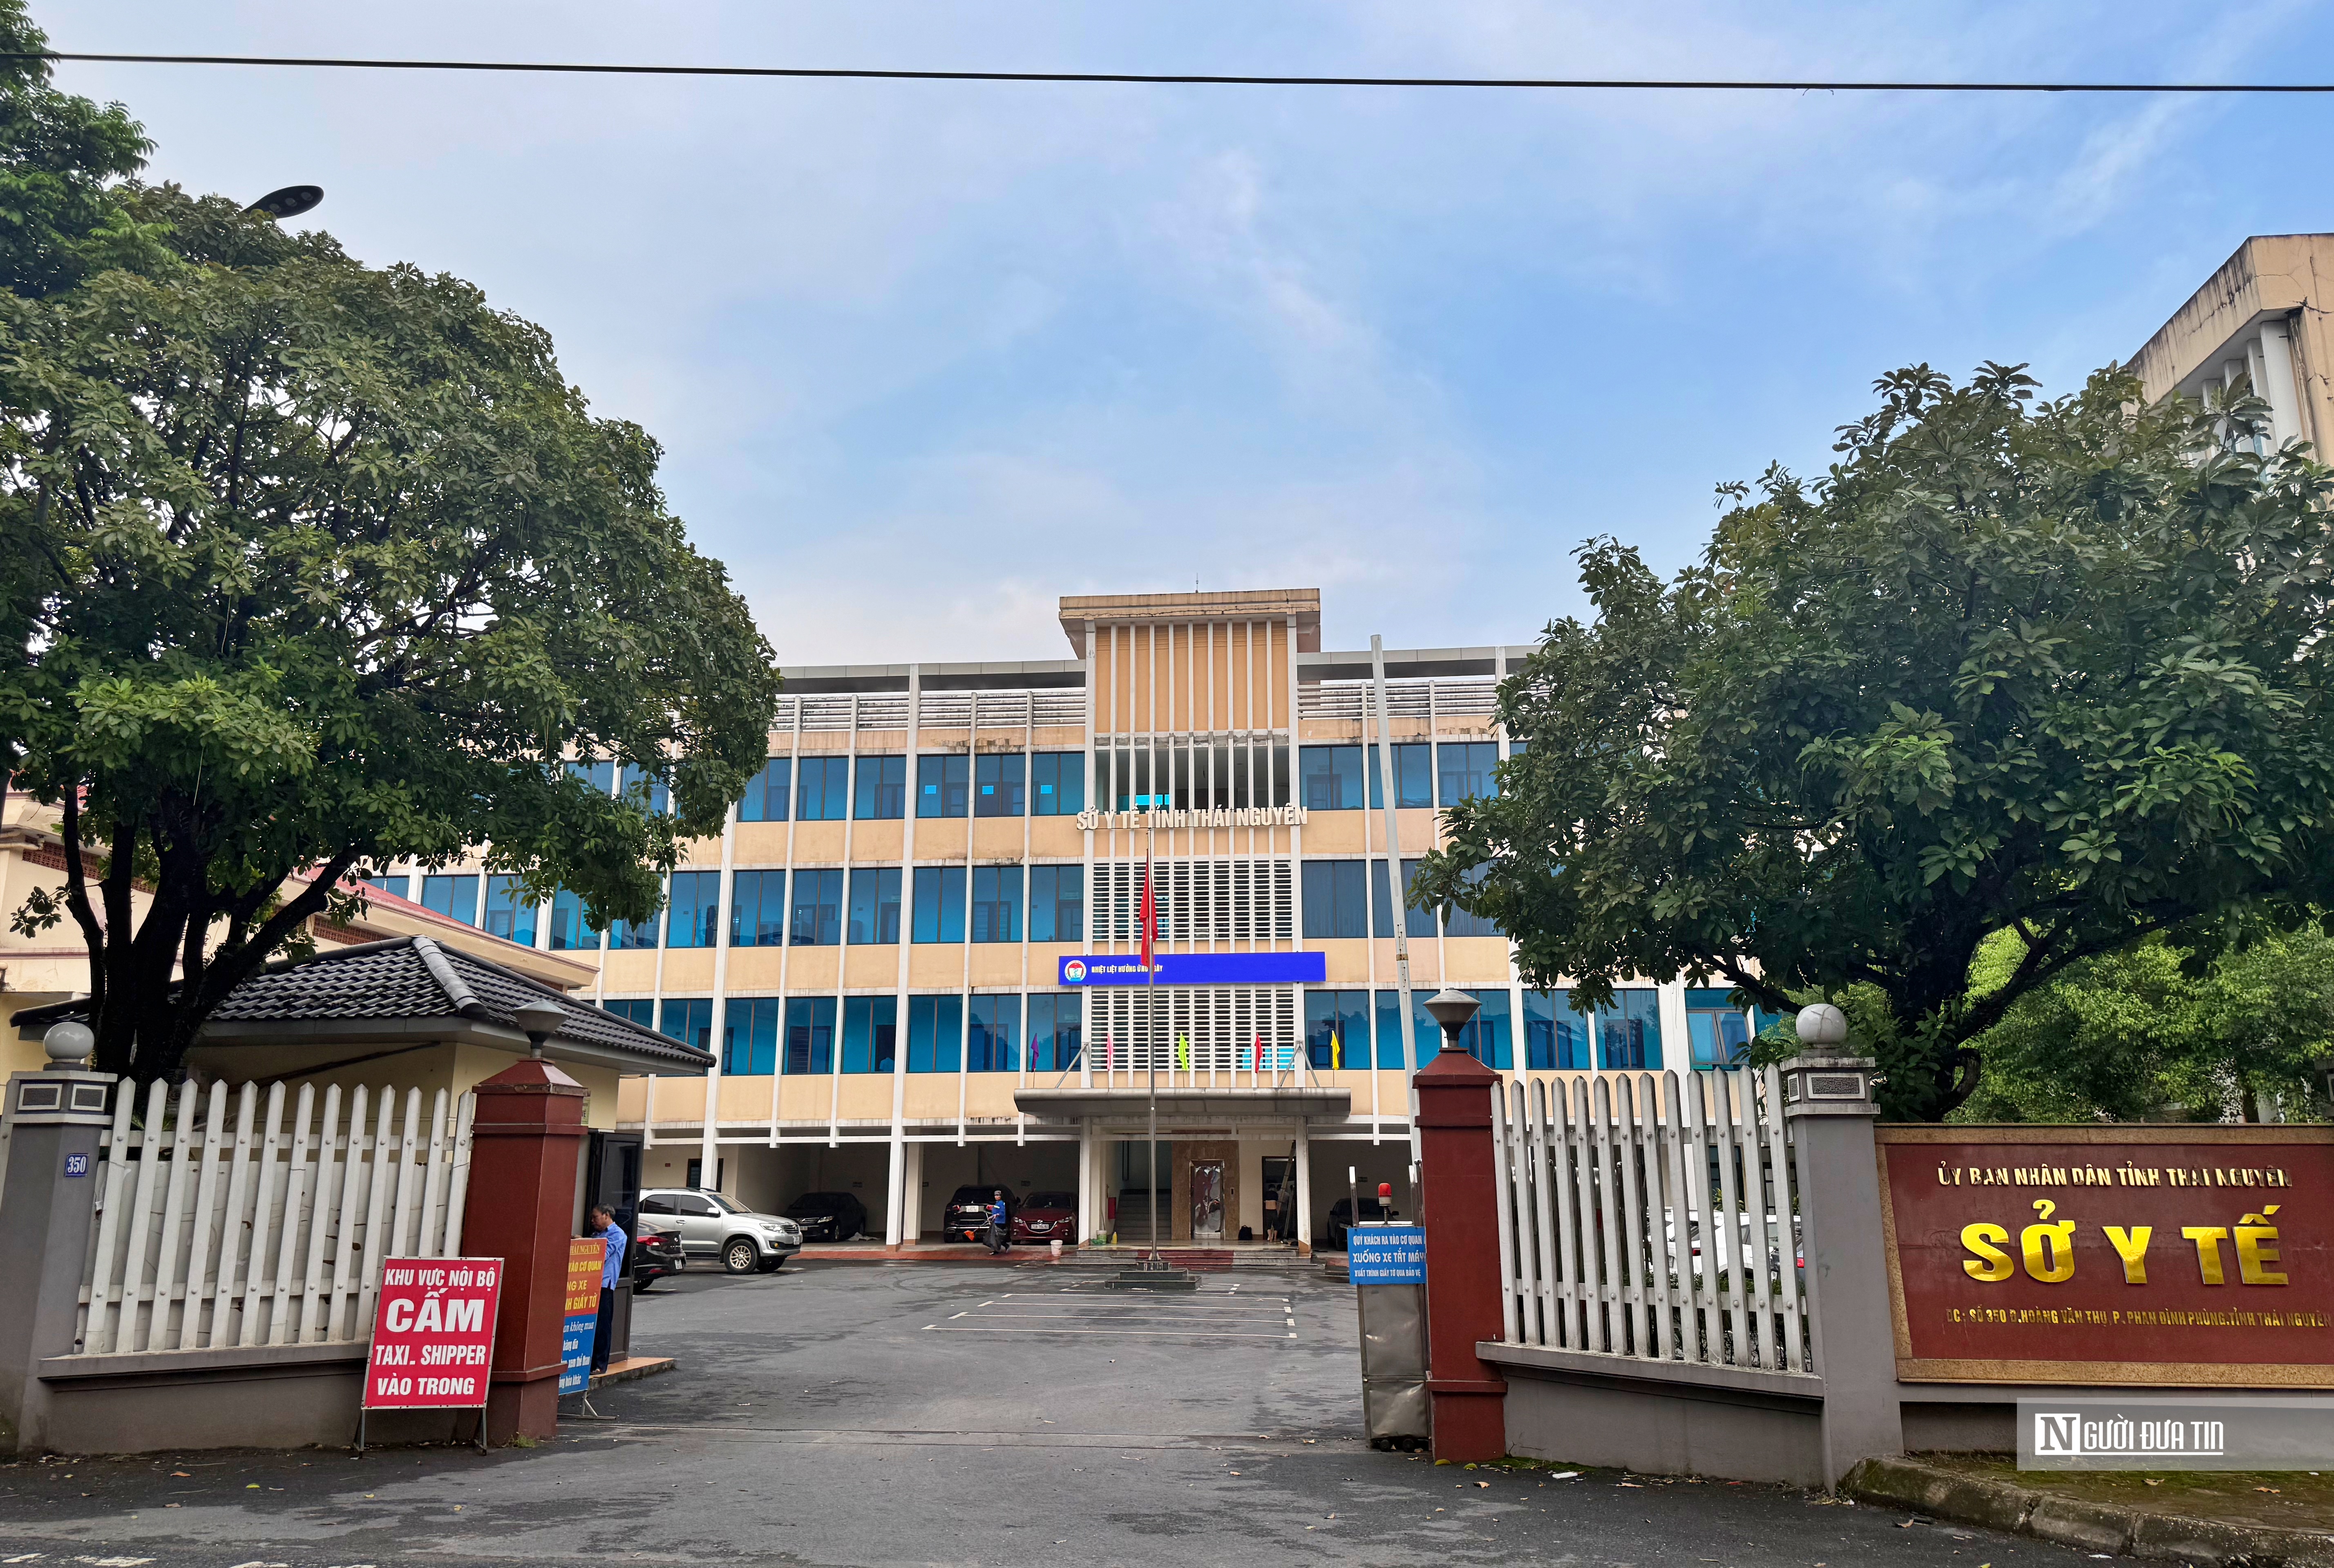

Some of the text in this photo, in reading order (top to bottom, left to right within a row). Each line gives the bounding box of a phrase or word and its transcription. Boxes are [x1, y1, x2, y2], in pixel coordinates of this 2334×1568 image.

[1076, 803, 1307, 830] SỞ Y TẾ TỈNH THÁI NGUYÊN
[1092, 965, 1106, 974] NHIỆT
[1107, 965, 1117, 974] LIỆT
[1118, 964, 1136, 973] HƯỞNG
[67, 1156, 86, 1173] 350
[1938, 1160, 2292, 1187] ỦY BAN NHÂN DÂN TỈNH THÁI NGUYÊN
[1353, 1234, 1363, 1246] QUÝ
[1364, 1234, 1380, 1245] KHÁCH
[1382, 1235, 1388, 1245] RA
[1389, 1234, 1399, 1244] VÀO
[1400, 1235, 1407, 1244] CƠ
[1408, 1235, 1422, 1245] QUAN
[1961, 1199, 2289, 1285] SỞ Y TẾ
[1353, 1249, 1381, 1263] XUỐNG
[1382, 1252, 1392, 1262] XE
[1393, 1247, 1406, 1262] TẮT
[568, 1260, 602, 1273] VÀO CƠ QUAN
[1355, 1267, 1365, 1277] XUẤT
[1366, 1268, 1379, 1277] TRÌNH
[1379, 1267, 1389, 1277] GIẤY
[1390, 1268, 1396, 1277] TỜ
[385, 1266, 495, 1291] KHU VỰC NỘI BỘ
[578, 1280, 587, 1290] XE
[573, 1292, 588, 1309] GIẤY
[589, 1292, 597, 1308] TỜ
[386, 1288, 485, 1332] CẤM
[1970, 1304, 1983, 1322] SỐ
[1986, 1309, 2007, 1323] 350
[2061, 1307, 2084, 1323] VĂN
[2127, 1311, 2157, 1325] PHAN
[2159, 1308, 2186, 1325] ĐÌNH
[2257, 1309, 2285, 1326] THÁI
[2286, 1310, 2332, 1327] NGUYÊN
[376, 1345, 486, 1365] TAXI. SHIPPER
[378, 1372, 475, 1396] VÀO TRONG
